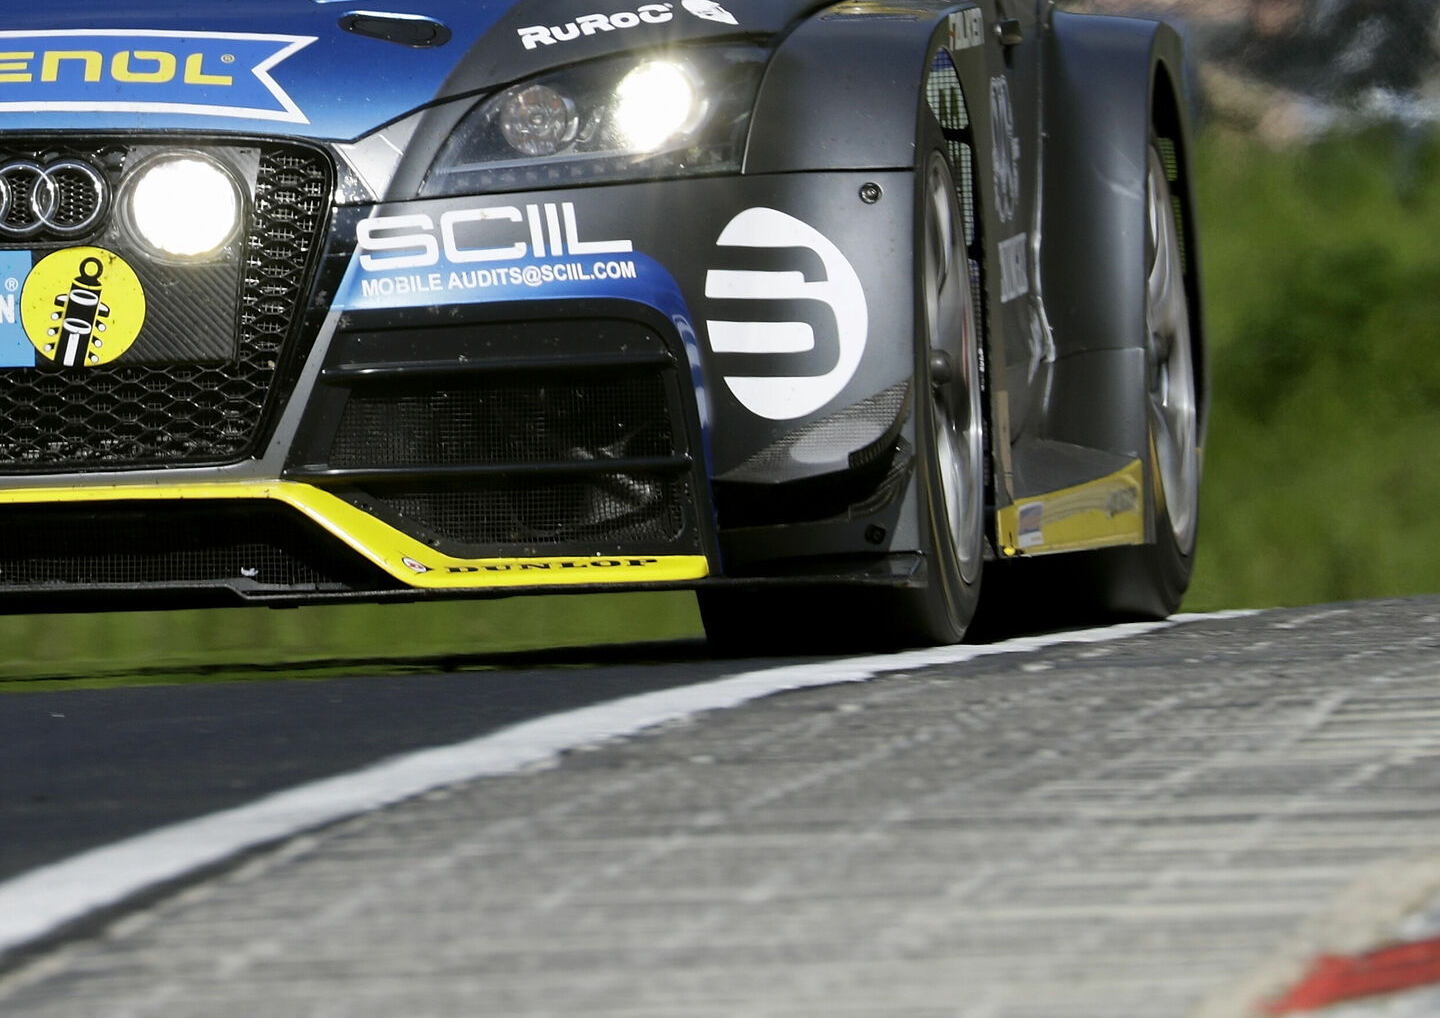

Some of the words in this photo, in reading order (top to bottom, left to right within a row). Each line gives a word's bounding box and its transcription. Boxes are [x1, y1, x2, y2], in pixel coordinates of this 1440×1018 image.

[356, 202, 633, 272] SCIIL
[361, 273, 444, 297] MOBILE
[448, 261, 637, 290] AUDITS@SCIIL.COM
[446, 558, 658, 573] DUNLOP
